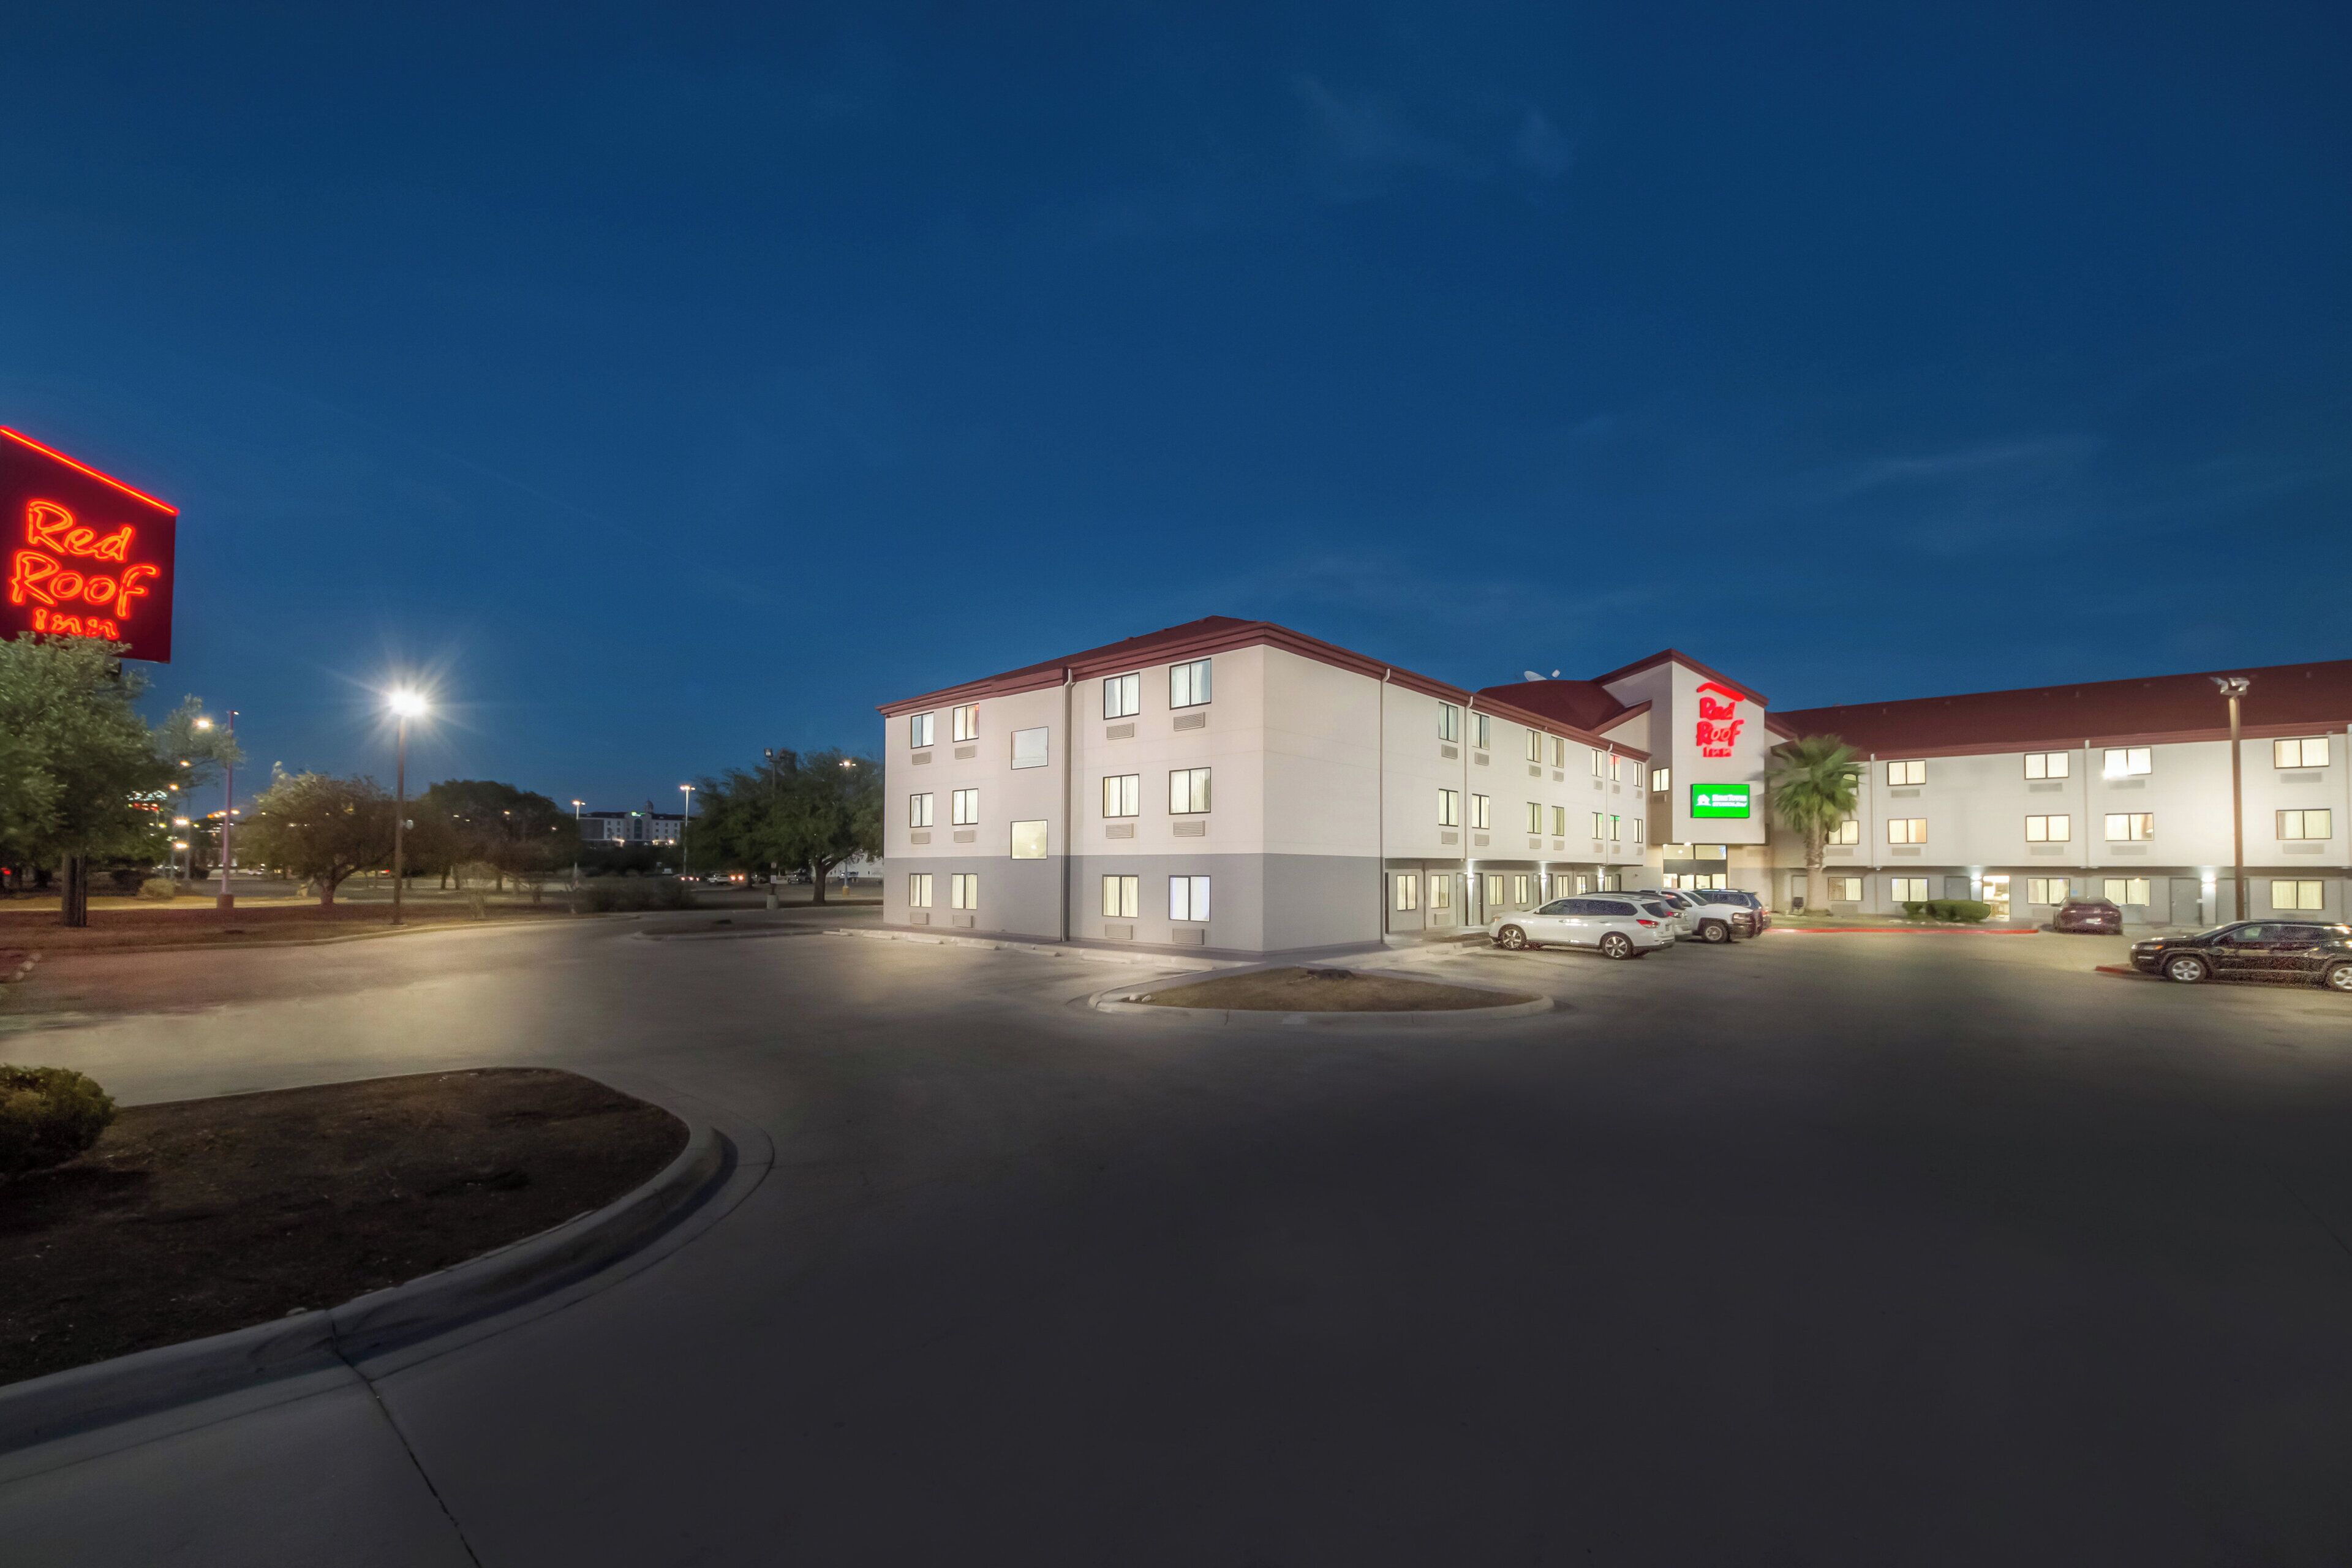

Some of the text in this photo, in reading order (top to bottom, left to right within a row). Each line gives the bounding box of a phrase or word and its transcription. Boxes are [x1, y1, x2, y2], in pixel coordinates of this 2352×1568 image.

[26, 499, 135, 562] Red
[9, 549, 159, 619] Roof
[33, 608, 119, 639] Inn
[1699, 696, 1735, 720] Red
[1696, 719, 1744, 747] Roof
